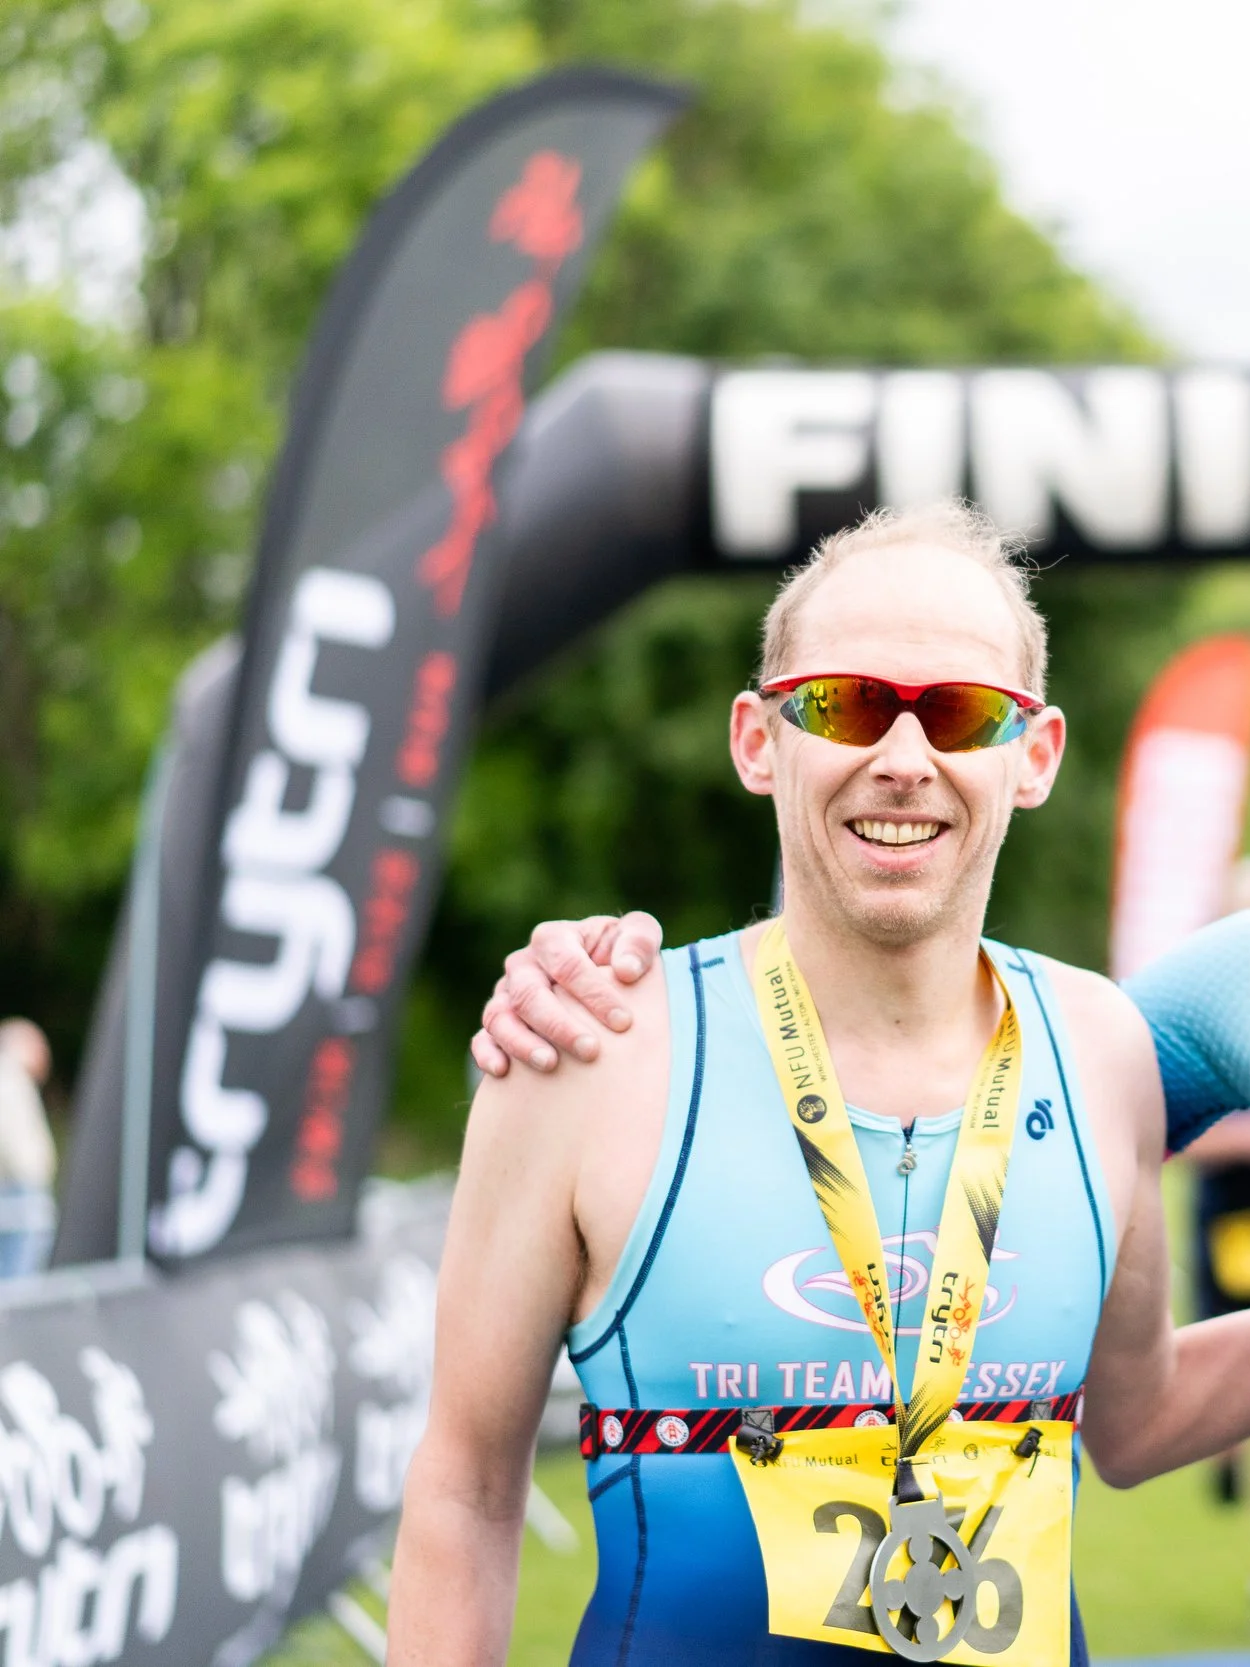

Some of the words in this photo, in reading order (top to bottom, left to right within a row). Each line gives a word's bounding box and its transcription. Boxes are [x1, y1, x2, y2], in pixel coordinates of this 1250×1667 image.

[765, 965, 800, 1041] Mutual
[798, 1002, 810, 1027] ALTON
[784, 1045, 814, 1090] NFU
[807, 1032, 827, 1083] WINCHESTER
[982, 1056, 1012, 1129] Mutual
[929, 1271, 959, 1364] trytri
[689, 1361, 760, 1400] TRI
[777, 1360, 892, 1400] TEAM
[914, 1360, 1067, 1399] ESSEX
[805, 1453, 859, 1467] Mutual
